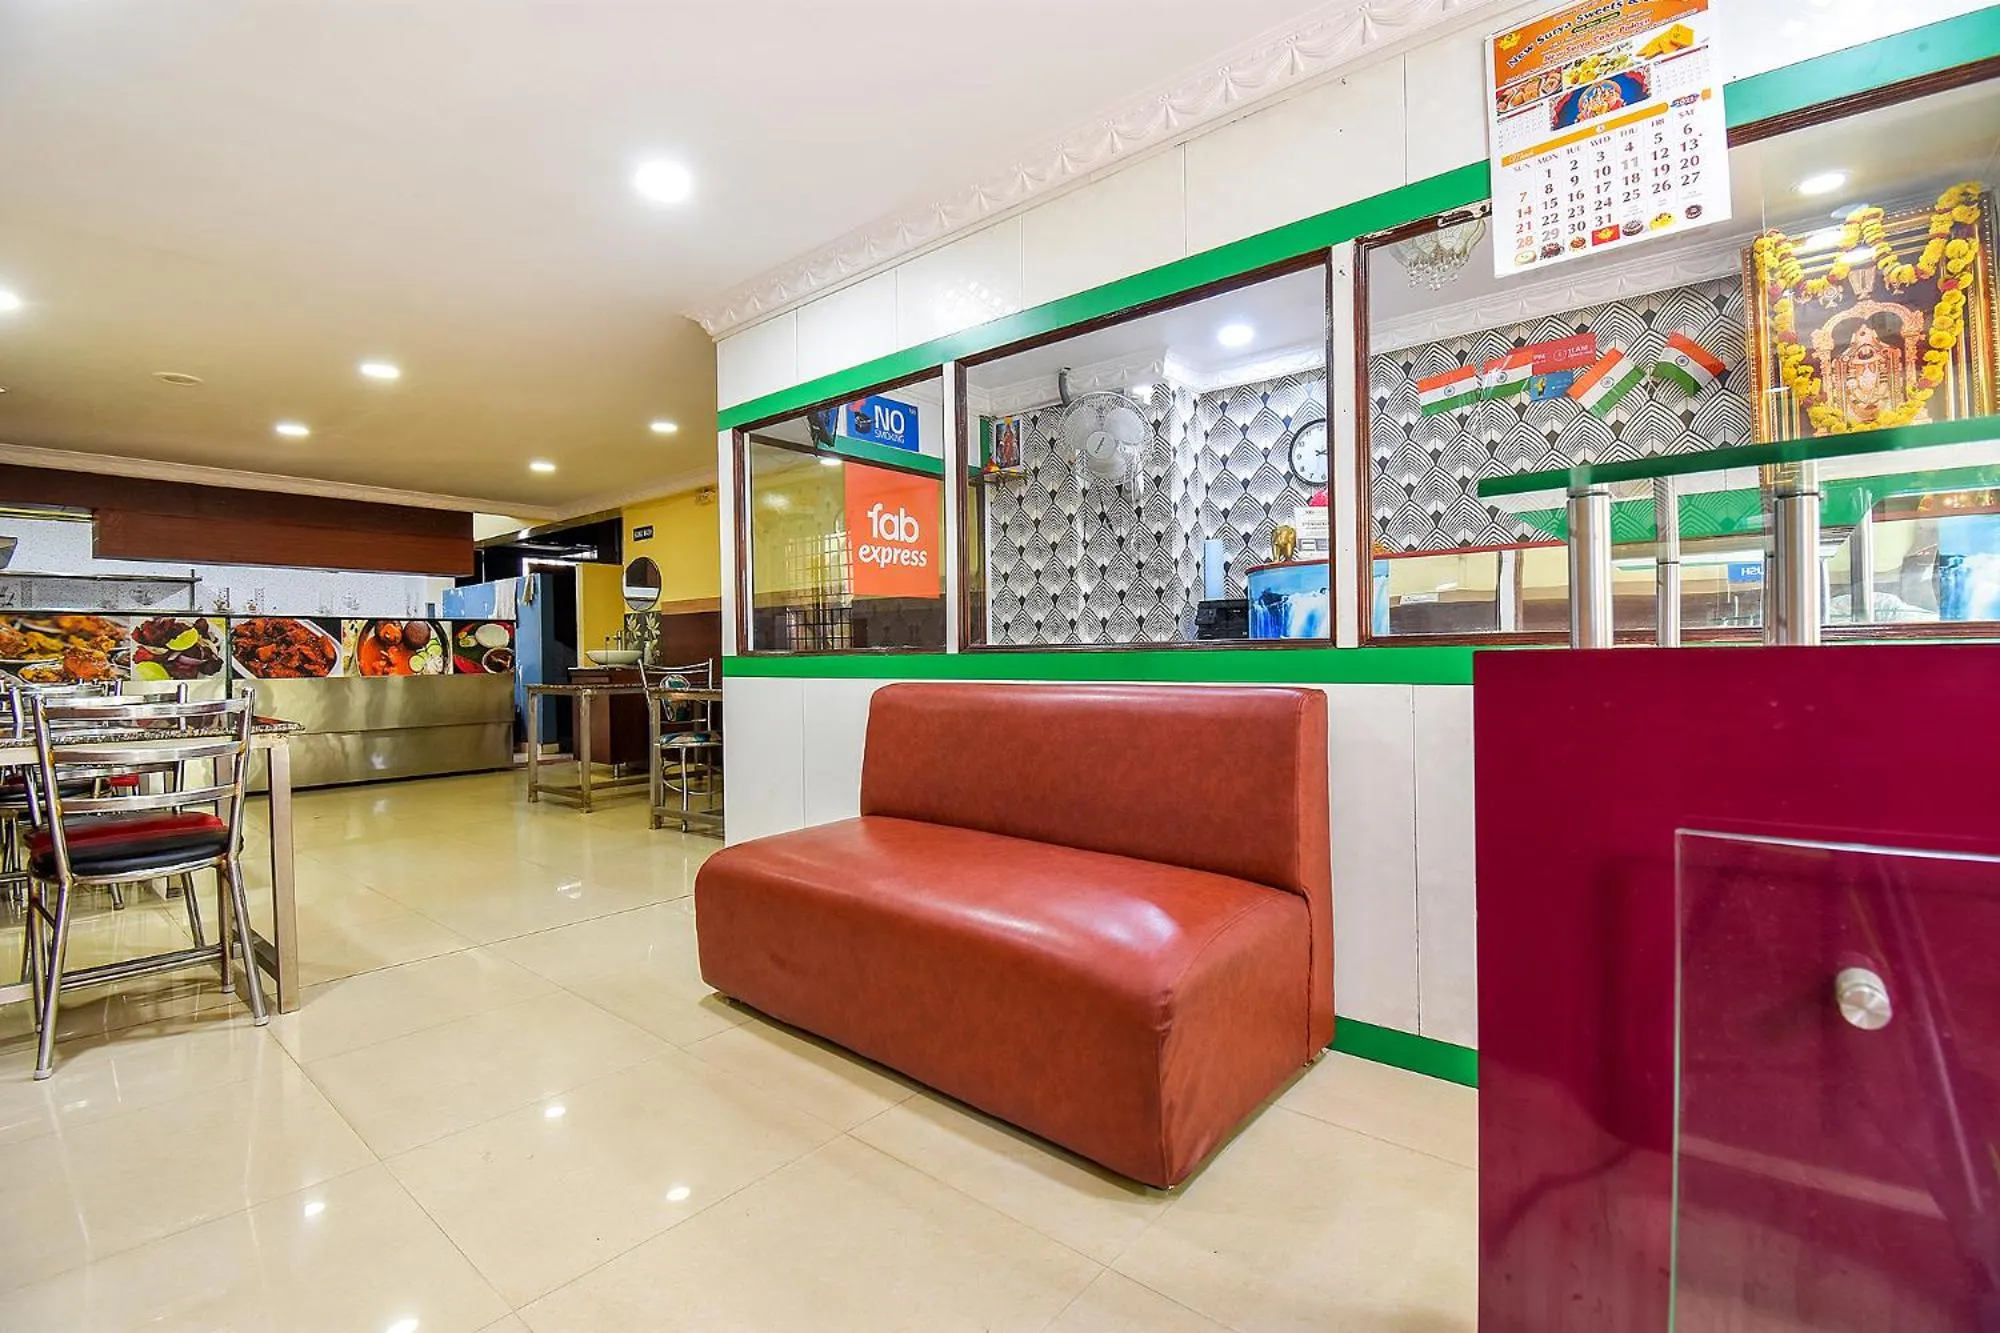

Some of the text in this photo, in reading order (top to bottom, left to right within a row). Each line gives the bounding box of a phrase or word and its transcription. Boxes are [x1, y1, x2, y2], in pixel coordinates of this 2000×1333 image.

[1507, 43, 1534, 68] New
[1536, 22, 1572, 46] Surya
[1576, 1, 1623, 24] Sweets
[1538, 153, 1558, 164] MON
[1566, 145, 1581, 154] TUE
[1590, 136, 1611, 147] WED
[1652, 118, 1664, 127] FRI
[1679, 109, 1694, 118] SAT
[1546, 123, 1692, 178] 1 2 3 4 5 6
[1517, 155, 1700, 218] 14 15 16 17 18 19 20
[1520, 138, 1698, 202] 7 8 9 10 11 12 13
[1516, 171, 1700, 234] 21 22 23 24 25 26 27
[1516, 214, 1612, 249] 28 29 30 31
[874, 405, 905, 435] NO
[874, 428, 905, 444] SMOKING
[867, 503, 920, 544] fab
[858, 543, 928, 568] express
